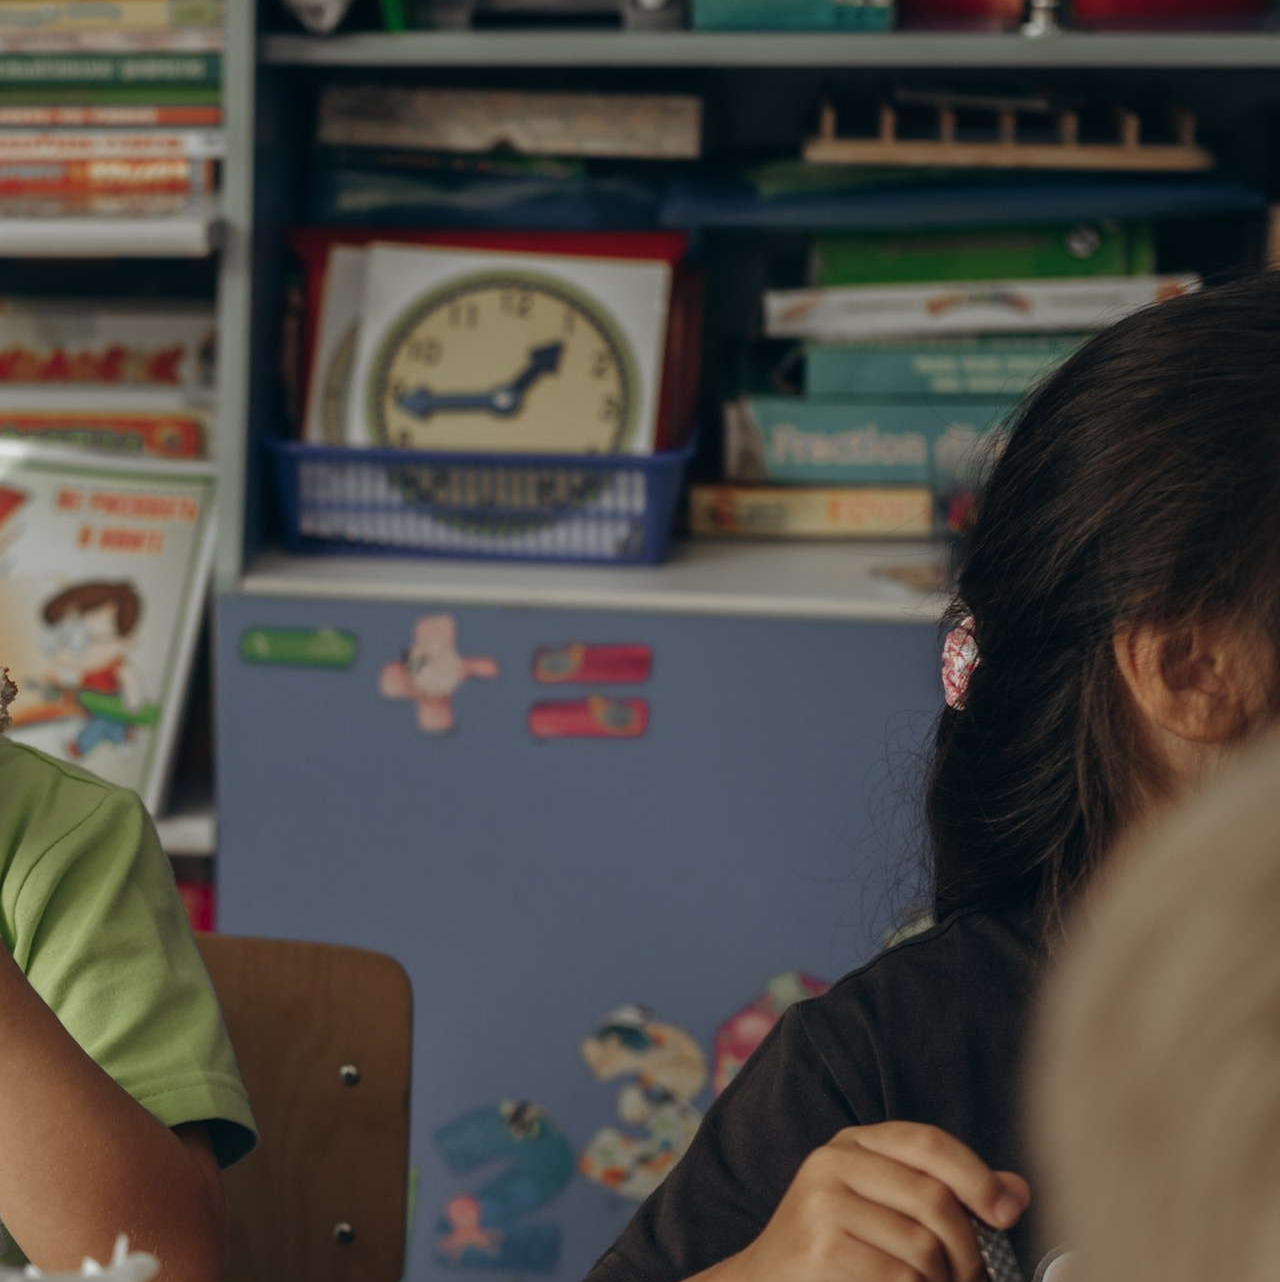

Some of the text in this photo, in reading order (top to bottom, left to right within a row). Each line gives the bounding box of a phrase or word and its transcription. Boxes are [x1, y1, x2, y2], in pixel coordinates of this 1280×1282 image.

[447, 301, 479, 330] 11
[499, 290, 534, 318] 12
[408, 336, 443, 367] 10
